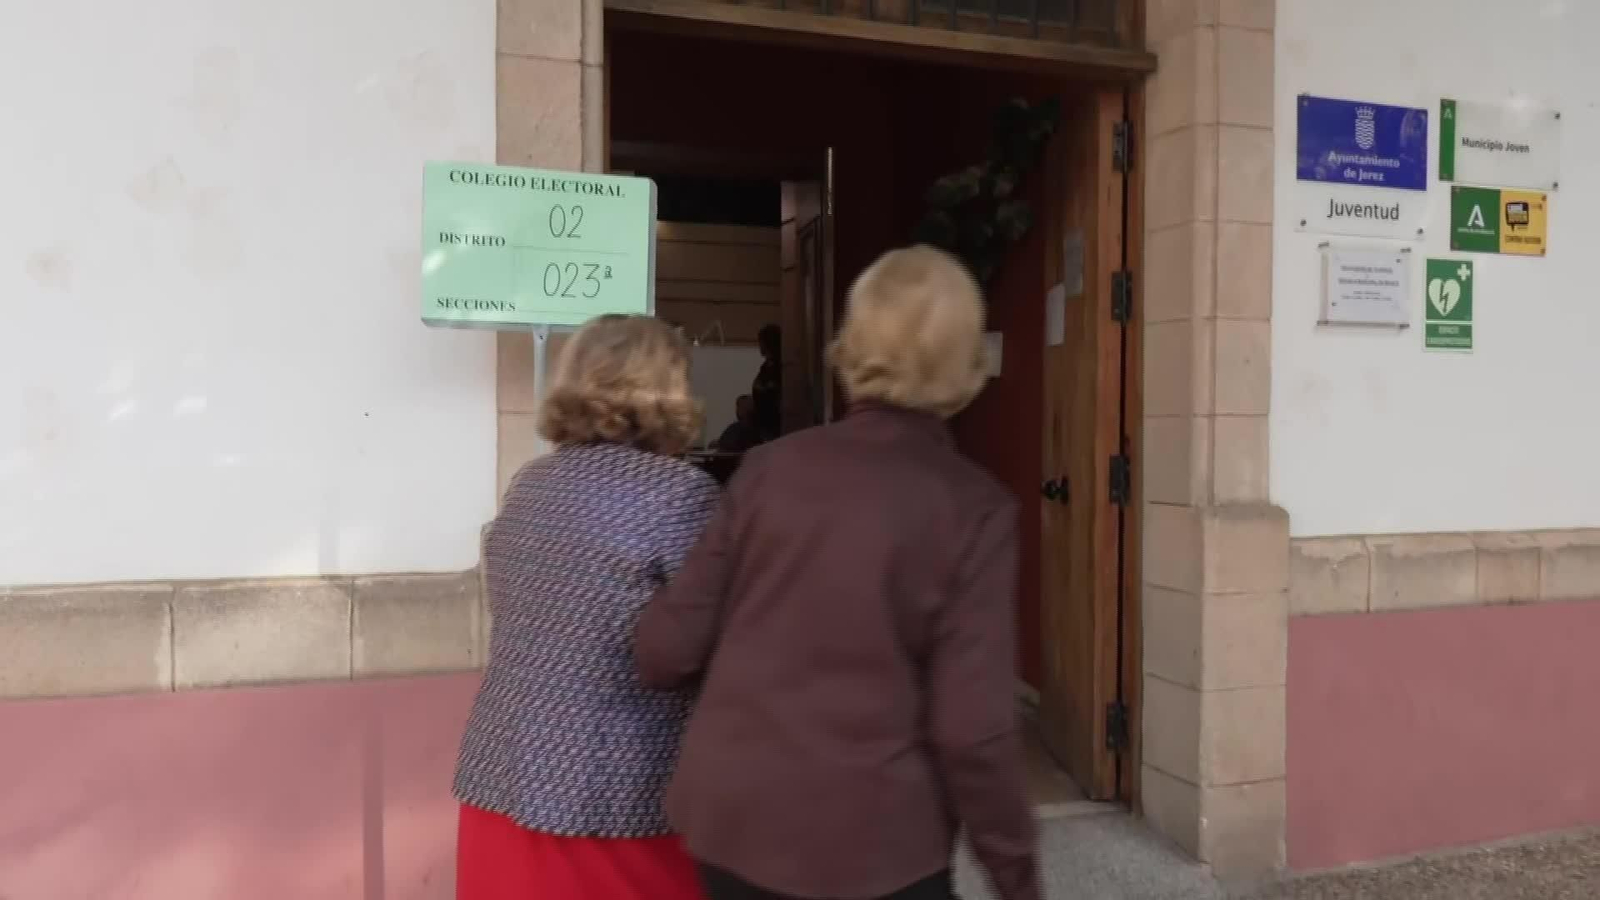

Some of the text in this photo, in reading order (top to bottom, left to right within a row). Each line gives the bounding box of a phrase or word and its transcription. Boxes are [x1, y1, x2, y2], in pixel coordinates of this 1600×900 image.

[1462, 137, 1530, 153] Municipio Joven
[1328, 151, 1400, 168] Ayuntamiento
[1343, 168, 1384, 181] de Jerez
[449, 169, 625, 198] COLEGIO ELECTORAL
[1327, 199, 1399, 220] Juventud
[549, 204, 584, 239] 02
[439, 231, 506, 247] DISTRITO
[437, 297, 516, 312] SECCIONES
